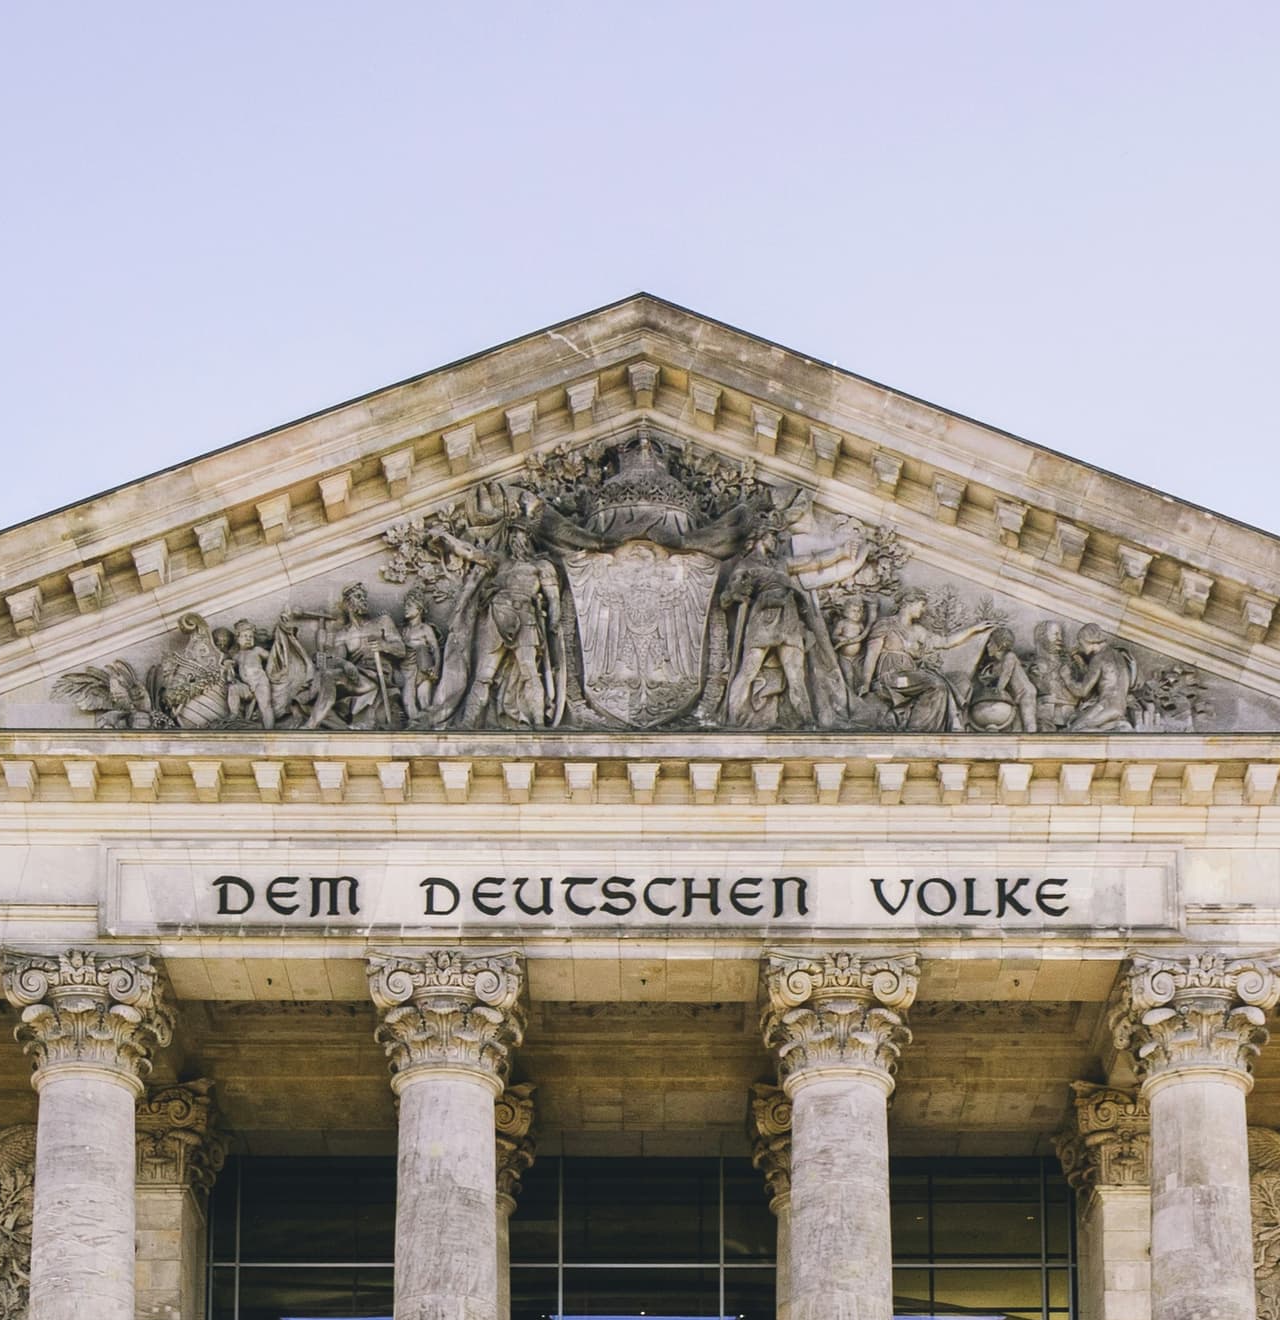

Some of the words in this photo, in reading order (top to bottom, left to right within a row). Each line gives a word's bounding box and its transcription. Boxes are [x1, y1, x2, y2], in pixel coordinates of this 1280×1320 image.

[212, 875, 361, 918] DEM
[419, 876, 809, 918] DEUTSCHEN
[870, 877, 1069, 918] VOLKE
